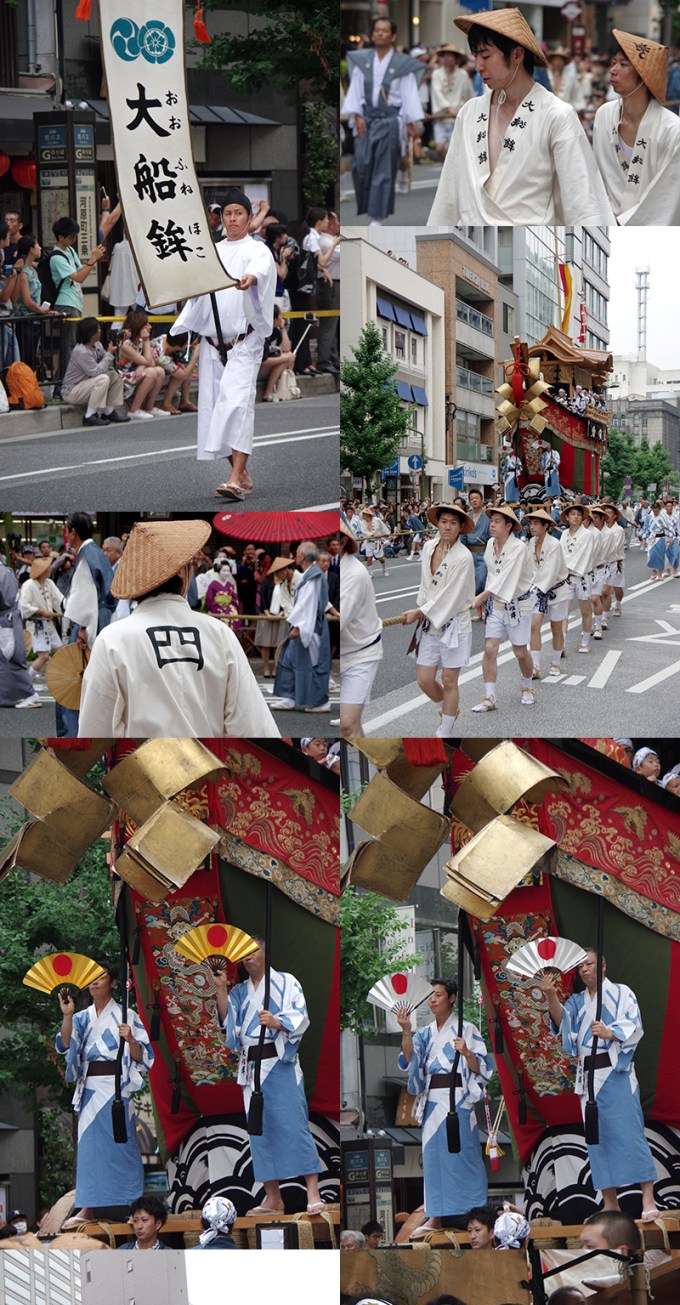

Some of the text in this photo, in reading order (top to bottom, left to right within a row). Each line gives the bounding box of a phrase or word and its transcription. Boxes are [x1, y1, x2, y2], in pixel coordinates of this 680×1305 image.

[126, 82, 194, 262] 大船鉾
[165, 90, 206, 259] おおふねほこ
